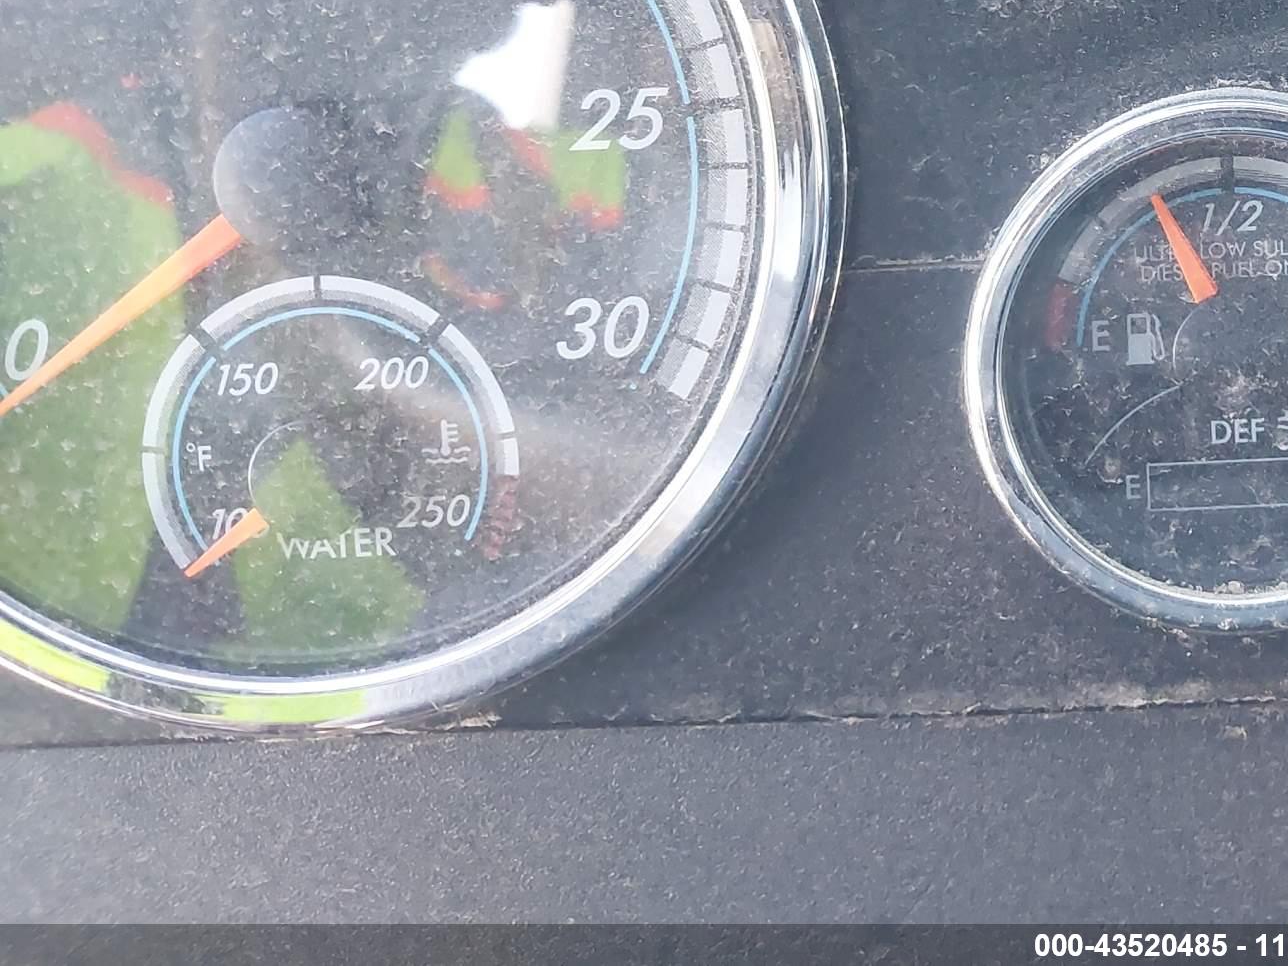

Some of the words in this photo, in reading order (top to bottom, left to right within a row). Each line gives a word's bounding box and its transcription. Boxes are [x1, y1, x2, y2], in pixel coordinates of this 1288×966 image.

[569, 88, 670, 153] 25
[1201, 200, 1264, 236] 1/2
[1134, 244, 1177, 264] ULT
[1201, 241, 1246, 260] LOW
[1140, 264, 1184, 282] DIES
[556, 296, 650, 360] 30
[1092, 320, 1110, 352] E
[4, 318, 49, 381] 0
[217, 362, 279, 396] 150
[354, 357, 429, 391] 200
[1210, 418, 1265, 444] DEF
[1125, 475, 1141, 500] E
[398, 495, 471, 530] 250
[276, 527, 397, 560] WATER
